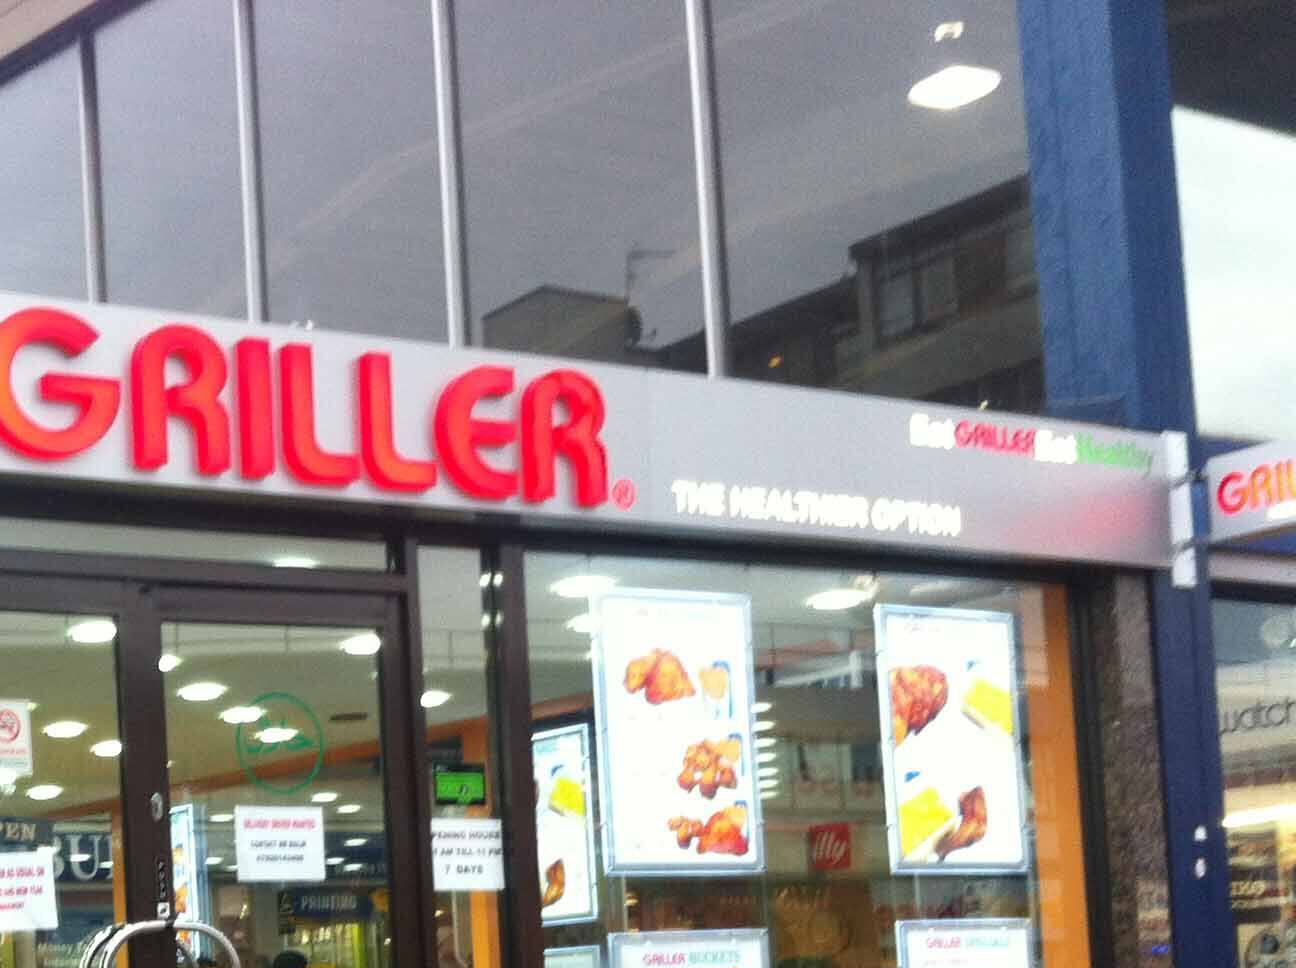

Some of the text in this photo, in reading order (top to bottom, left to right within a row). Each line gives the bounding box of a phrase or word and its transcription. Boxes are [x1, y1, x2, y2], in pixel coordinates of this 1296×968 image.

[671, 479, 961, 537] THE HEALTHIER OPTION
[815, 831, 848, 865] illy
[642, 952, 686, 967] GRILLER
